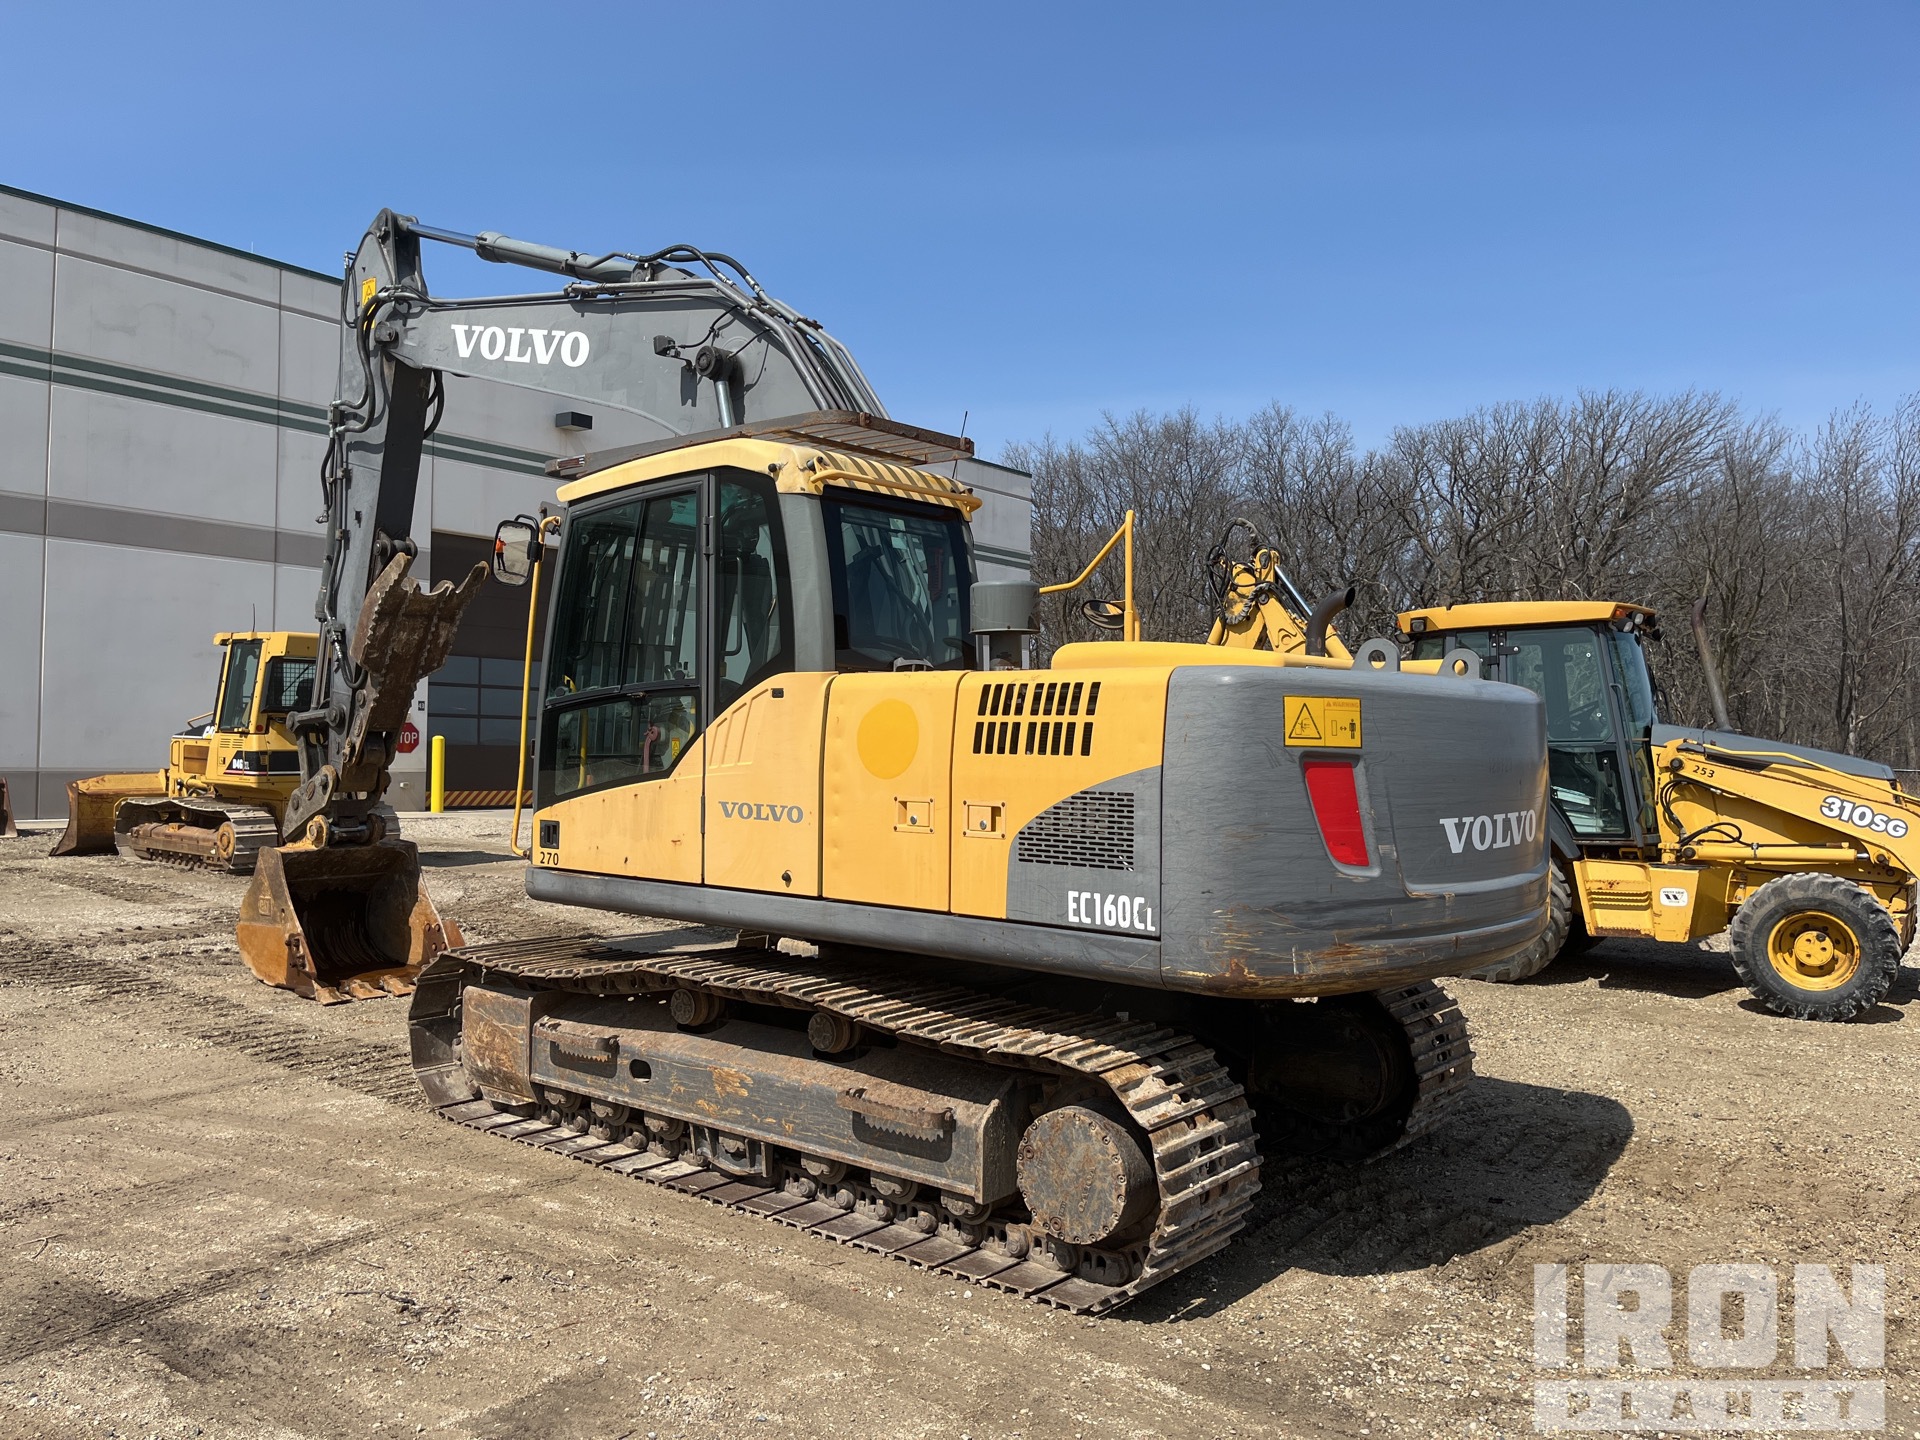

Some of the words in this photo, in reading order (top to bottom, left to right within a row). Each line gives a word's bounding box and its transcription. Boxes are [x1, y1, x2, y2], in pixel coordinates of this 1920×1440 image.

[451, 324, 590, 367] VOLVO
[400, 731, 418, 744] TOP
[1692, 764, 1715, 778] 253
[718, 801, 804, 824] VOLVO
[1820, 795, 1909, 838] 310SG
[1439, 809, 1536, 854] VOLVO
[540, 851, 559, 866] 270
[1068, 890, 1156, 932] EC160CL
